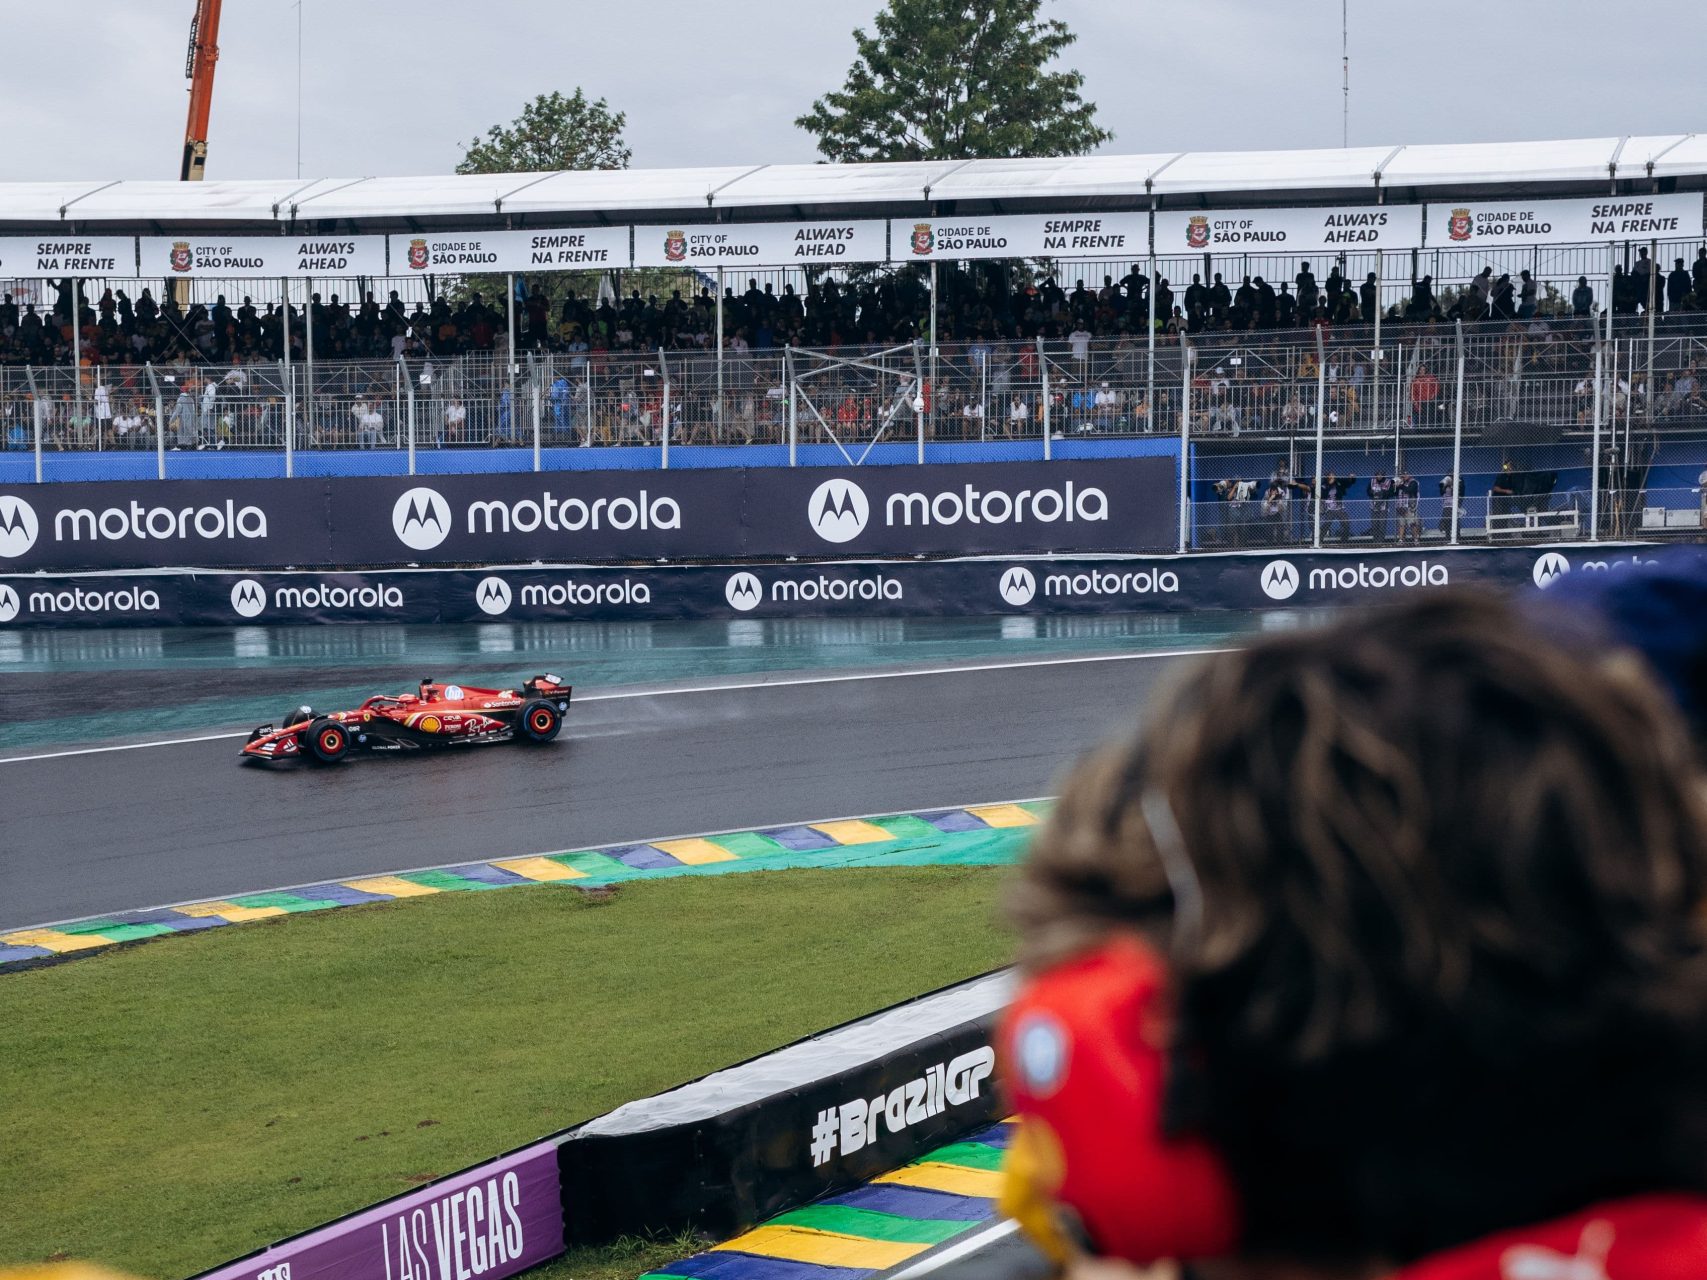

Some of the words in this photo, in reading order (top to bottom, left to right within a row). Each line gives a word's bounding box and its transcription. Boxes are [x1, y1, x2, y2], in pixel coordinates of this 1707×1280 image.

[1476, 211, 1514, 223] CIDADE
[1517, 211, 1534, 221] DE
[1591, 202, 1654, 218] SEMPRE
[1043, 219, 1102, 234] SEMPRE
[1213, 220, 1237, 232] CITY
[1239, 219, 1254, 230] OF
[1324, 212, 1388, 227] ALWAYS
[1590, 220, 1616, 234] NA
[1621, 217, 1679, 233] FRENTE
[794, 227, 854, 241] ALWAYS
[937, 227, 973, 237] CIDADE
[975, 226, 991, 236] DE
[1213, 229, 1241, 243] SÃO
[1243, 230, 1287, 242] PAULO
[1323, 229, 1379, 243] AHEAD
[1476, 222, 1505, 236] SÃO
[1507, 222, 1552, 235] PAULO
[531, 234, 586, 249] SEMPRE
[690, 235, 712, 244] CITY
[714, 234, 728, 244] OF
[937, 237, 964, 251] SÃO
[965, 237, 1008, 249] PAULO
[1043, 236, 1067, 249] NA
[1071, 235, 1126, 249] FRENTE
[36, 242, 92, 256] SEMPRE
[195, 246, 218, 256] CITY
[219, 246, 233, 256] OF
[297, 242, 355, 255] ALWAYS
[431, 242, 467, 254] CIDADE
[468, 241, 482, 251] DE
[690, 244, 717, 257] SÃO
[718, 244, 759, 256] PAULO
[794, 243, 846, 257] AHEAD
[196, 255, 222, 268] SÃO
[223, 257, 264, 268] PAULO
[297, 257, 348, 270] AHEAD
[432, 251, 457, 265] SÃO
[458, 252, 498, 264] PAULO
[531, 251, 553, 264] NA
[557, 249, 609, 263] FRENTE
[37, 258, 60, 270] NA
[64, 258, 116, 270] FRENTE
[886, 480, 1109, 526] motorola
[467, 489, 681, 534] motorola
[54, 499, 268, 541] motorola
[1044, 567, 1179, 596] motorola
[1309, 560, 1449, 590] motorola
[520, 578, 651, 606] motorola
[771, 574, 903, 601] motorola
[29, 586, 160, 613] motorola
[275, 583, 404, 608] motorola
[491, 698, 521, 709] Santander
[810, 1045, 995, 1168] #BrazilGP
